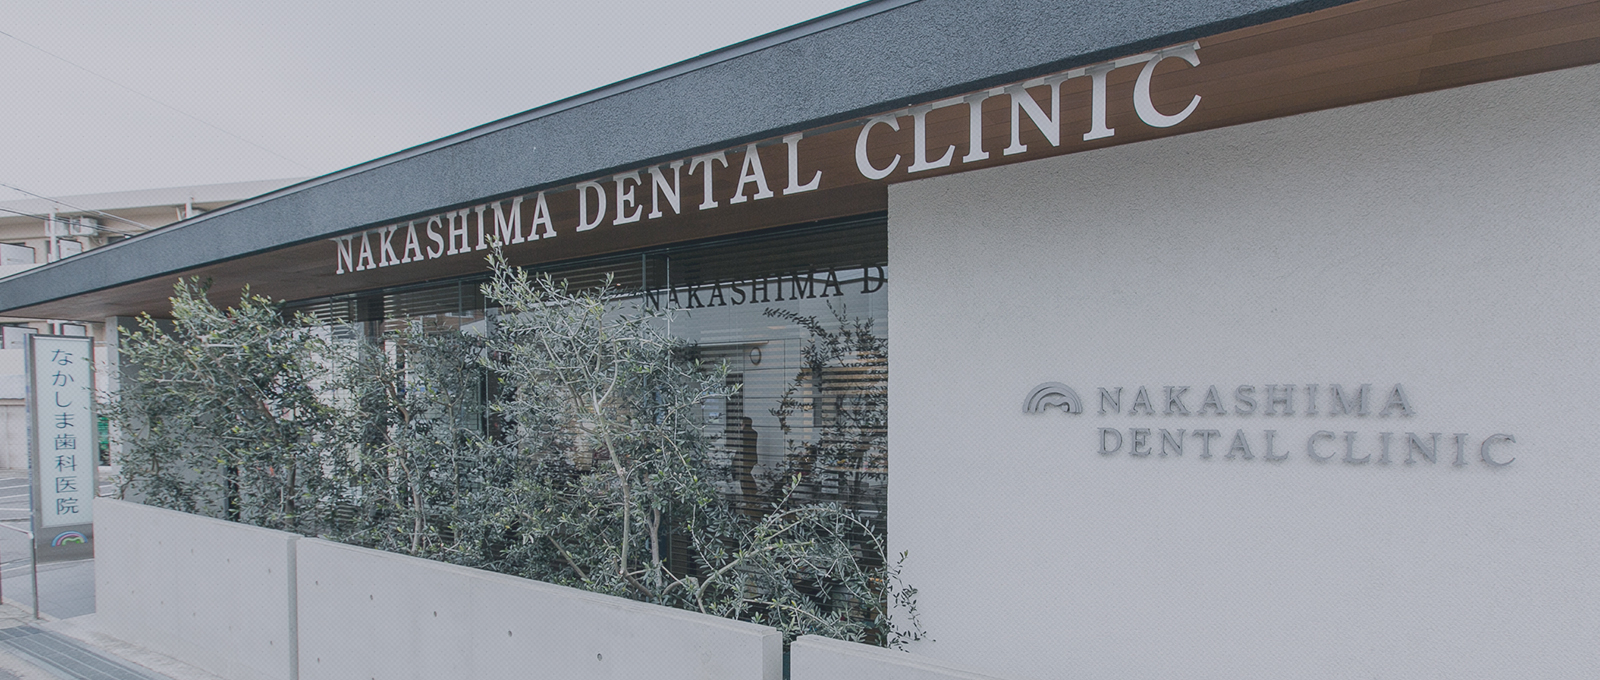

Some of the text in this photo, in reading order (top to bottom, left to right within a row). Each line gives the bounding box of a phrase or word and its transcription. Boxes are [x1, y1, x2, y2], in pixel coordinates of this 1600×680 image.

[335, 41, 1202, 275] NAKASHIMA DENTAL CLINIC
[645, 268, 843, 311] NAKASHIMA
[1097, 382, 1416, 418] NAKASHIMA
[51, 349, 79, 515] なかしま歯科医院
[1097, 426, 1518, 468] DENTAL CLINIC
